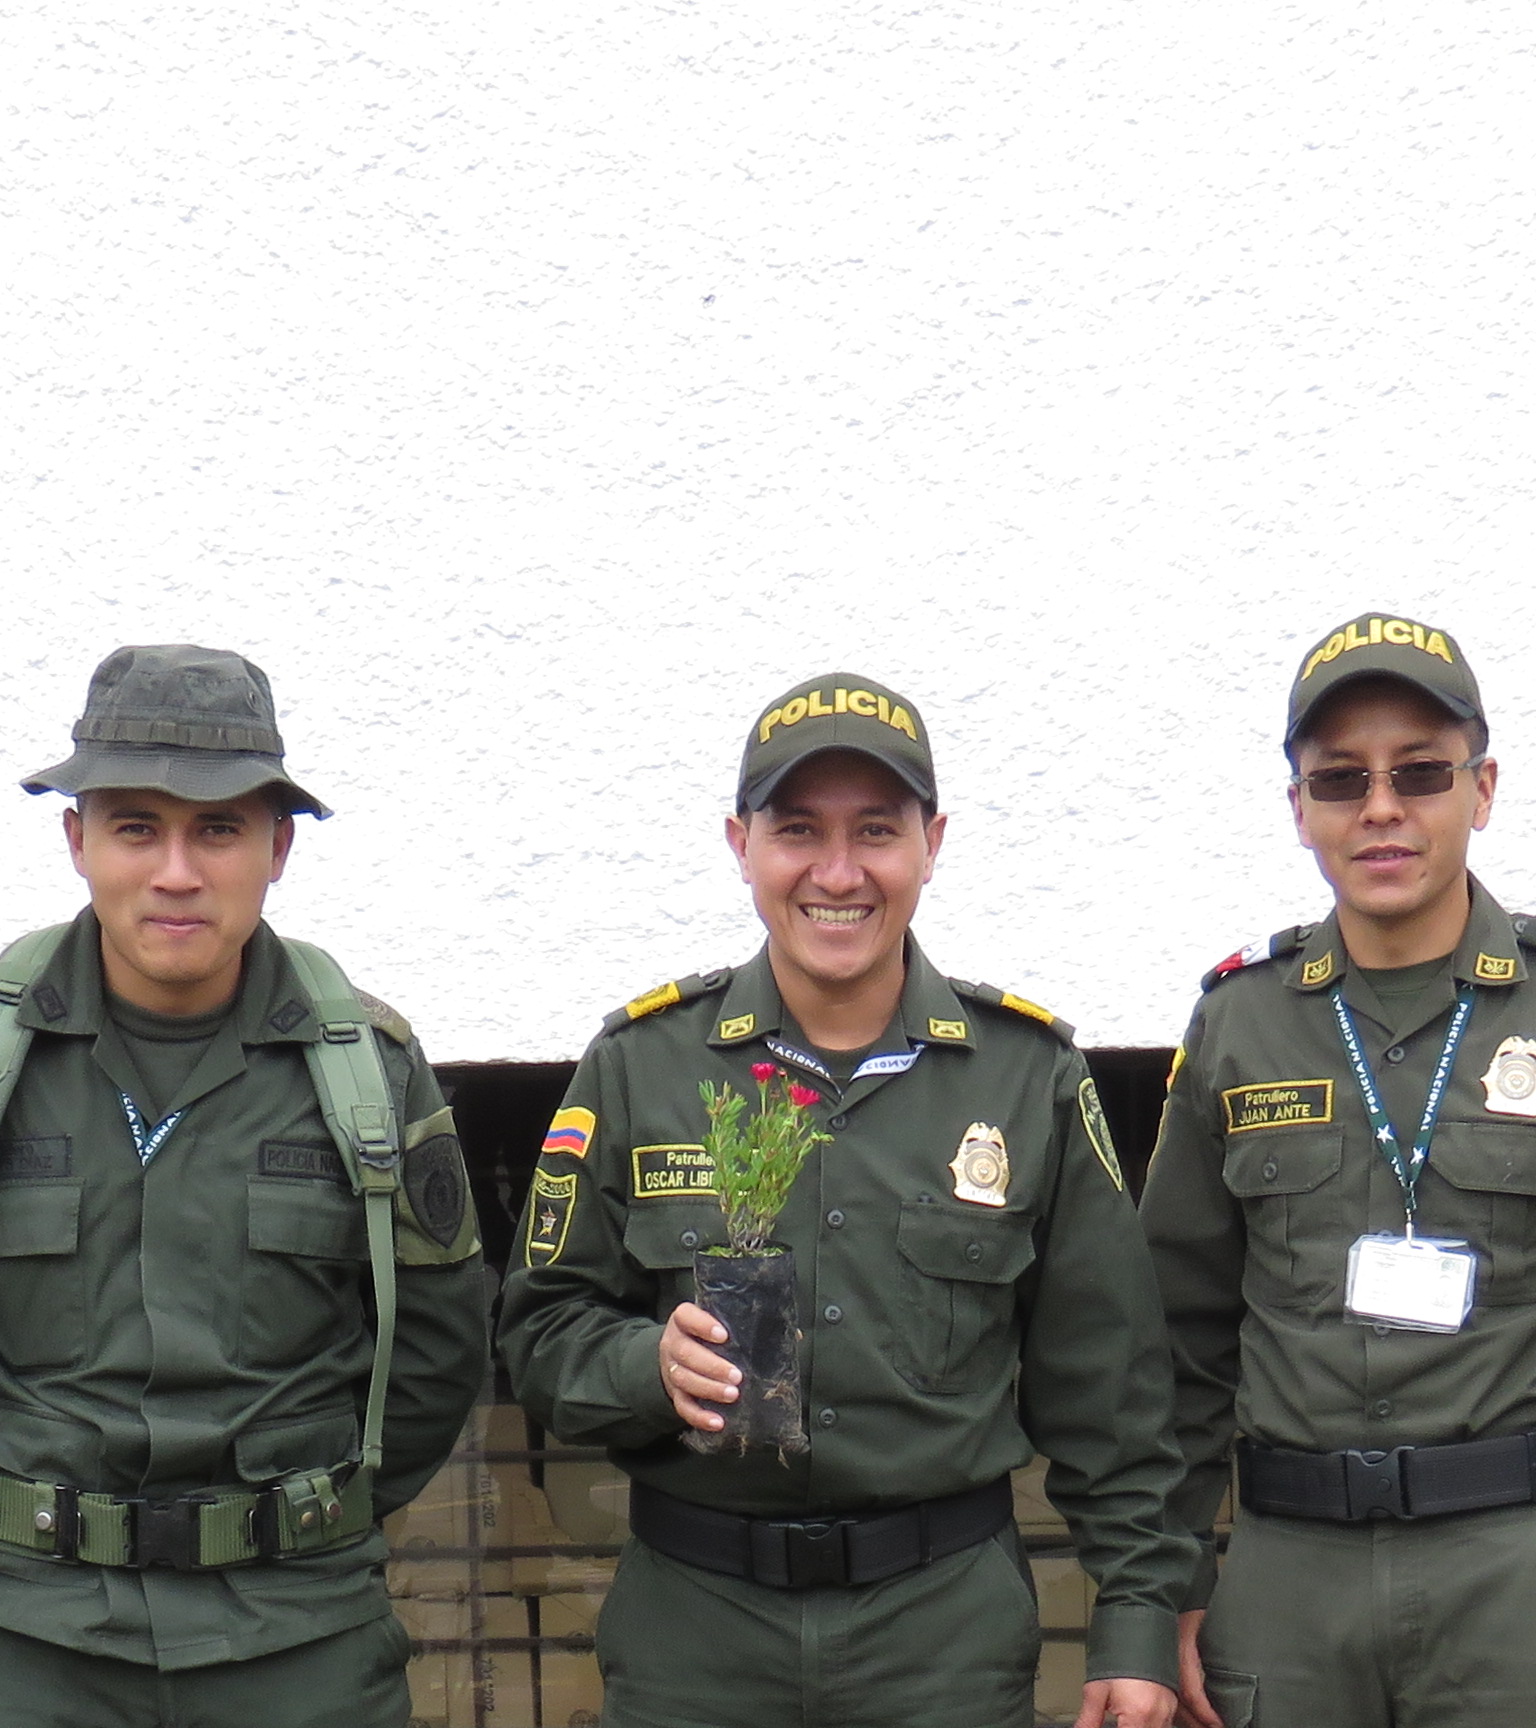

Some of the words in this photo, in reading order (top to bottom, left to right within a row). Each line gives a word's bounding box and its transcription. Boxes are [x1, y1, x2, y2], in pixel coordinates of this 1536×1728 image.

[1301, 618, 1453, 680] POLICIA
[758, 688, 917, 742] POLICIA
[1244, 1089, 1300, 1108] Patrullero
[1239, 1105, 1270, 1125] JUAN
[1274, 1103, 1312, 1120] ANTE
[645, 1171, 684, 1189] OSCAR
